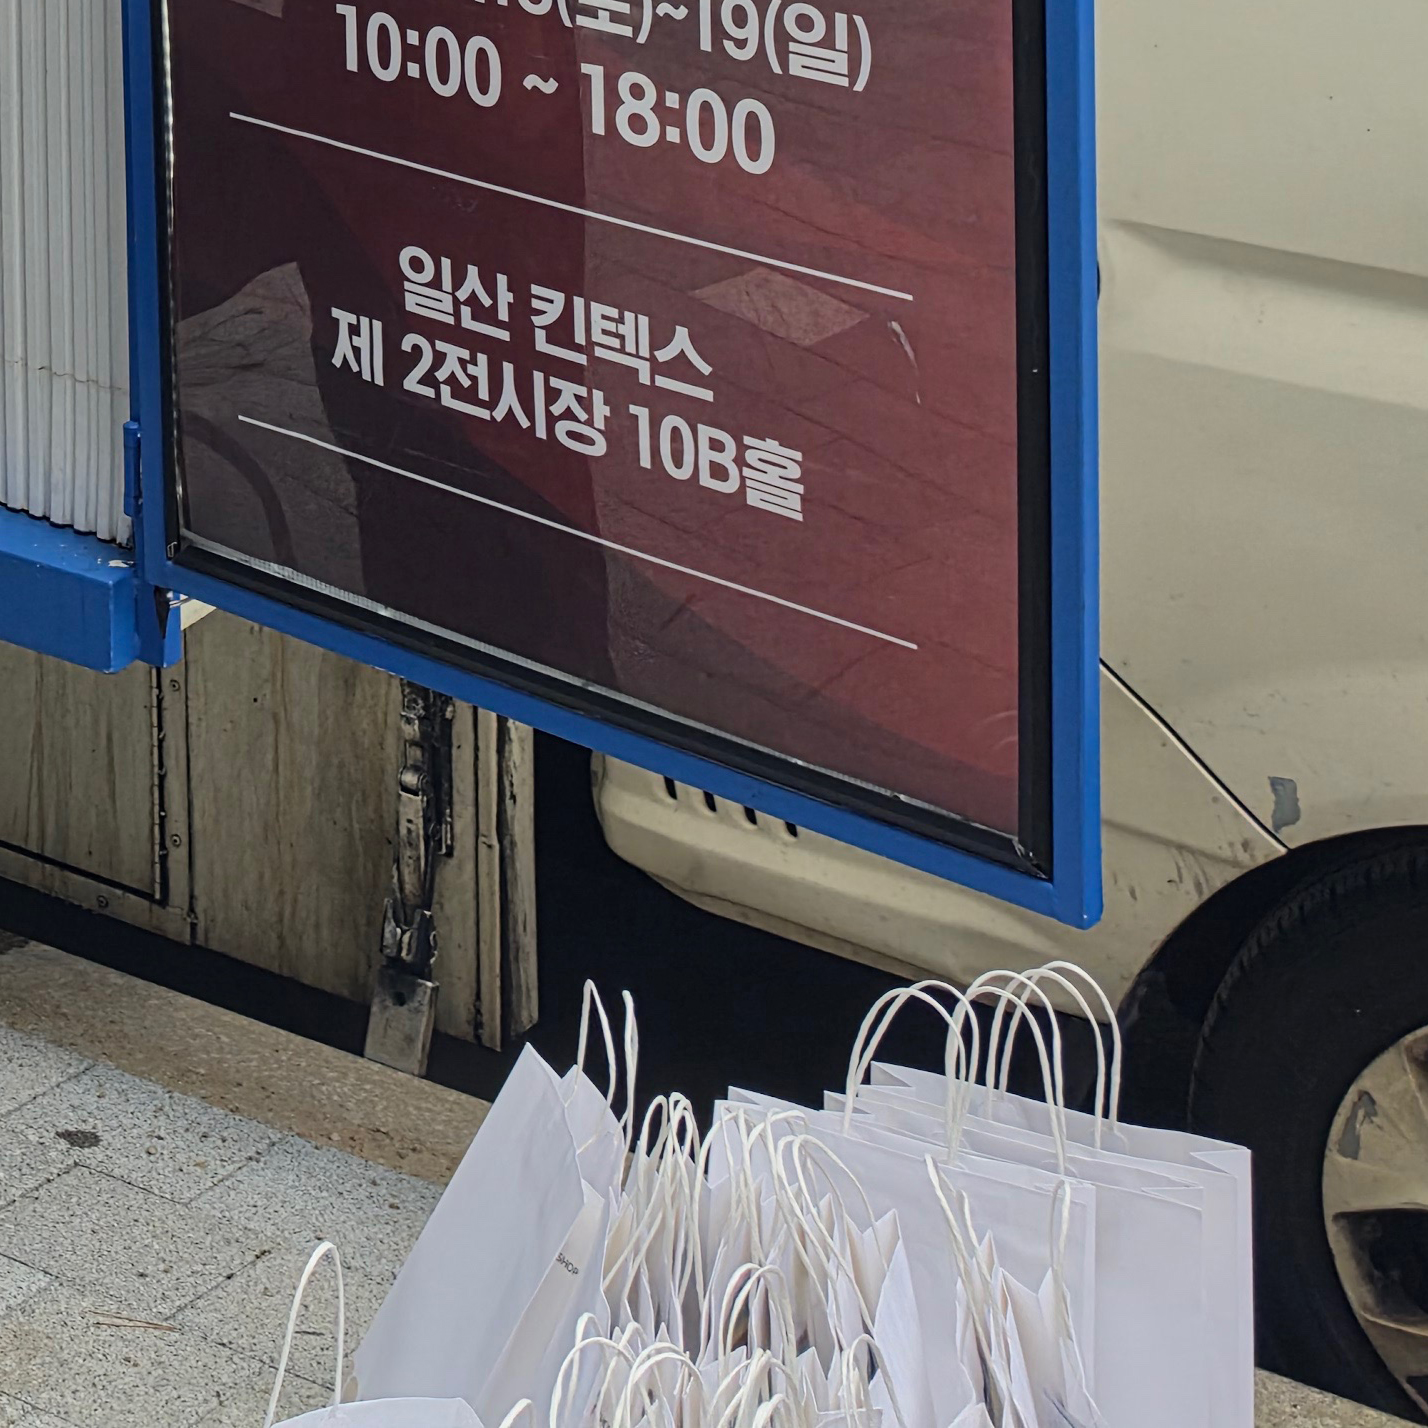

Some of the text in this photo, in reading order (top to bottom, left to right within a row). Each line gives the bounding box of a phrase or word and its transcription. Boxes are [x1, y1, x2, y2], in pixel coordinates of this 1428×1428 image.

[336, 4, 501, 107] 10:00
[581, 63, 775, 174] 18:00
[399, 246, 714, 403] 일산 킨텍스
[331, 307, 804, 521] 제 2전시장 10B홀
